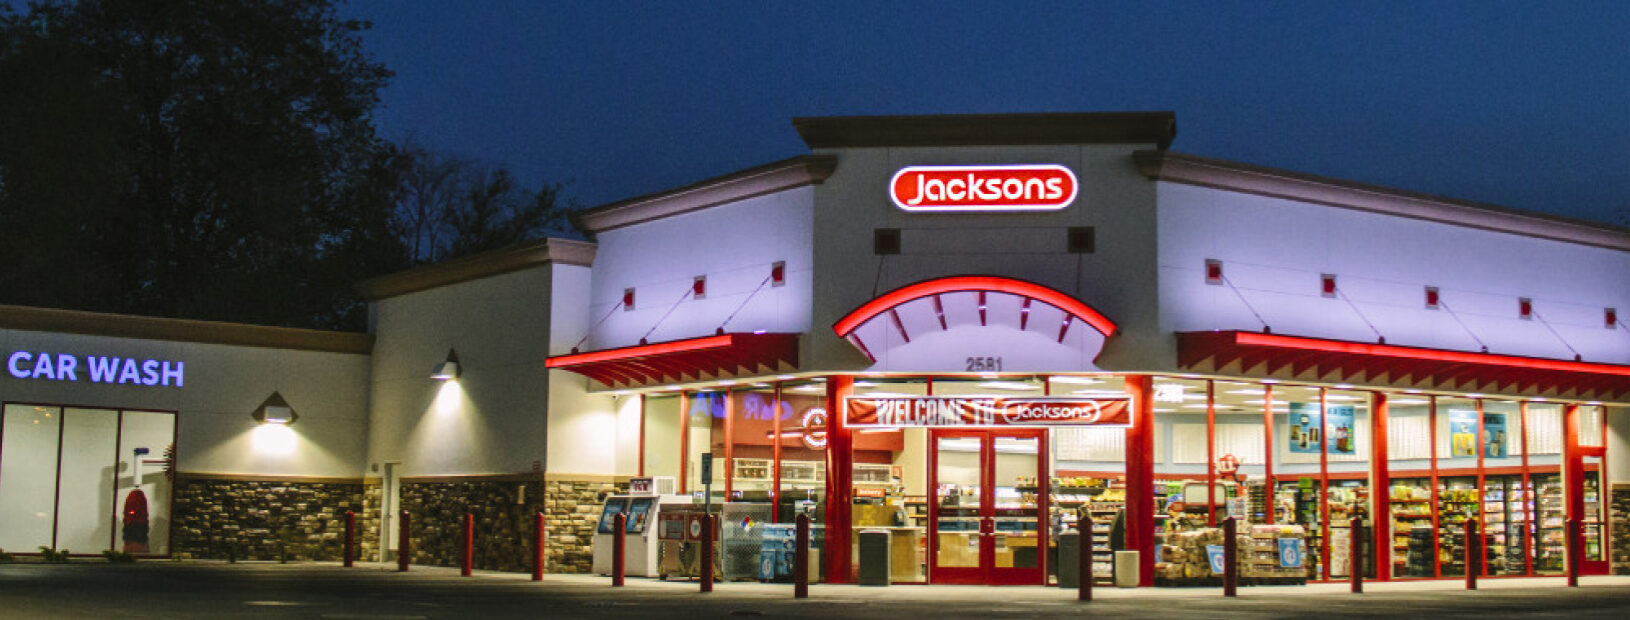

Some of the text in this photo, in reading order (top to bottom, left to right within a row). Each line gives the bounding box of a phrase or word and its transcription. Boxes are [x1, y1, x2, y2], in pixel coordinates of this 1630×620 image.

[908, 173, 1062, 204] Jacksons
[8, 351, 184, 387] CAR WASH
[966, 357, 1002, 373] 2581
[876, 398, 1091, 425] WELCOME TO Jacksons
